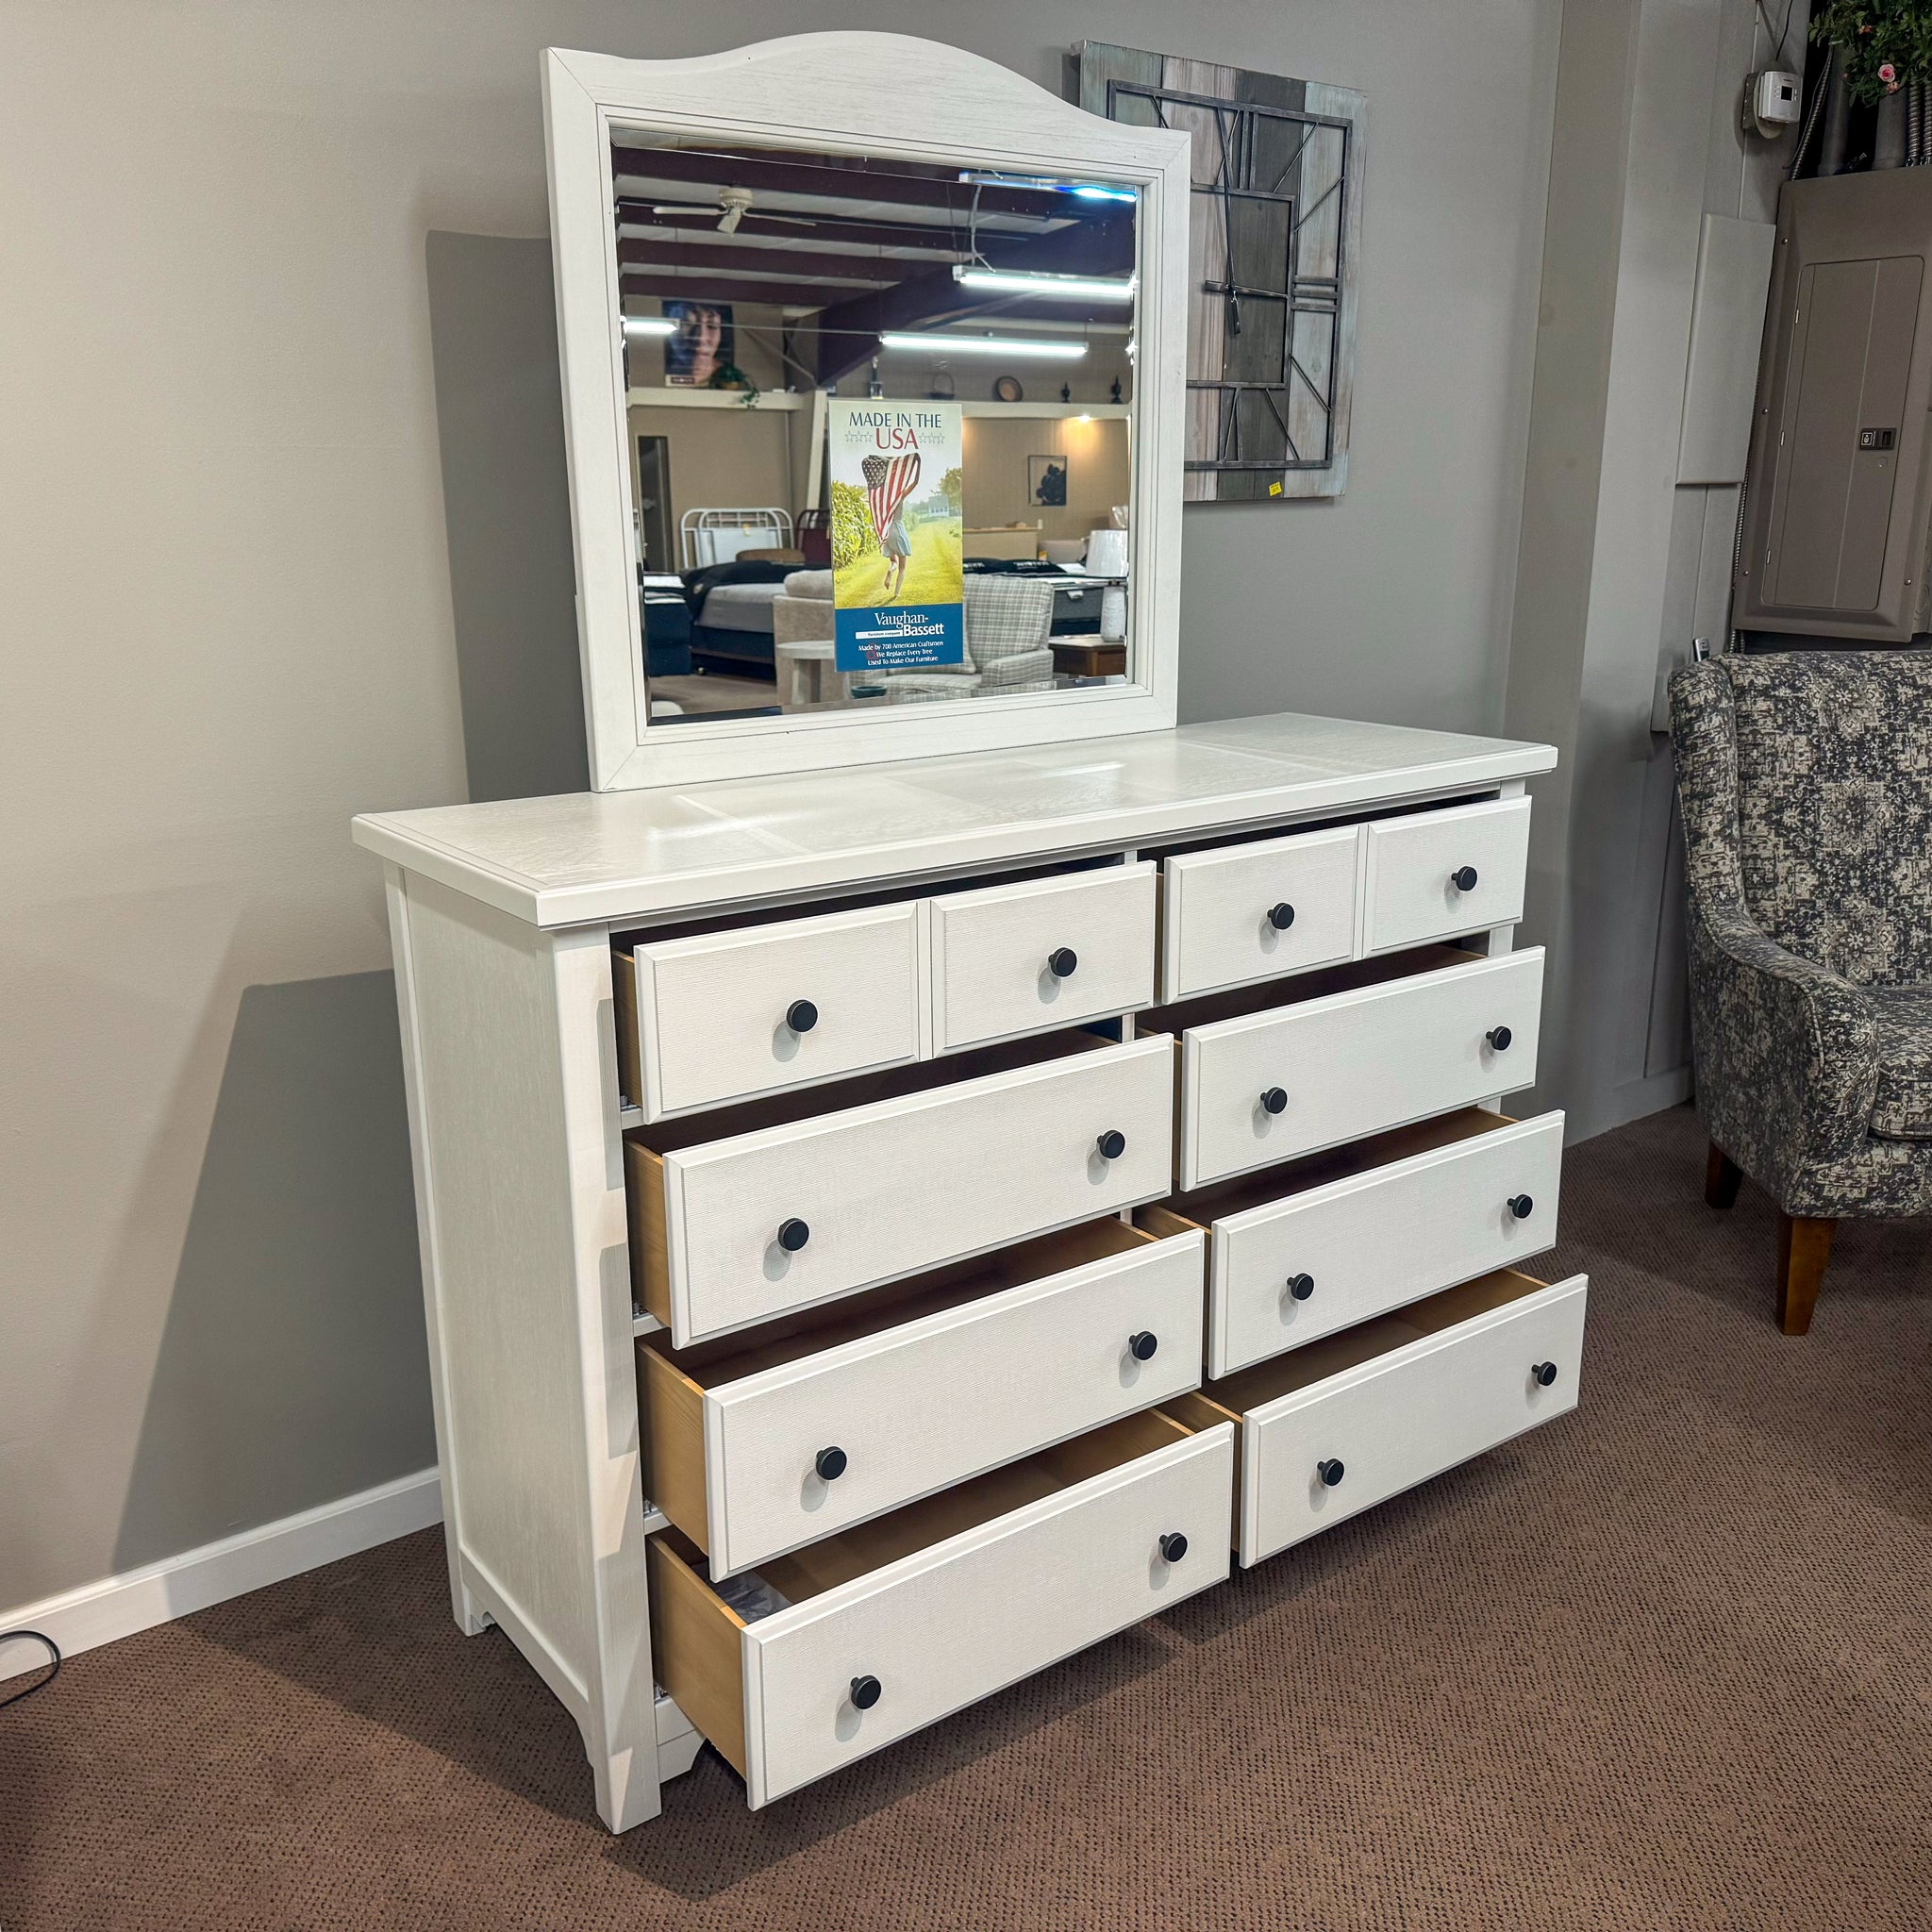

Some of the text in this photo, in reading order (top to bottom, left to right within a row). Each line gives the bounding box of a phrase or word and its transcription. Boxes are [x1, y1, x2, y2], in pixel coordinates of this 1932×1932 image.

[849, 411, 941, 428] MADE IN THE
[875, 427, 919, 450] USA
[874, 610, 929, 629] Vaughan-
[903, 623, 944, 637] Bassett
[892, 641, 917, 650] American
[915, 655, 939, 663] Furniture
